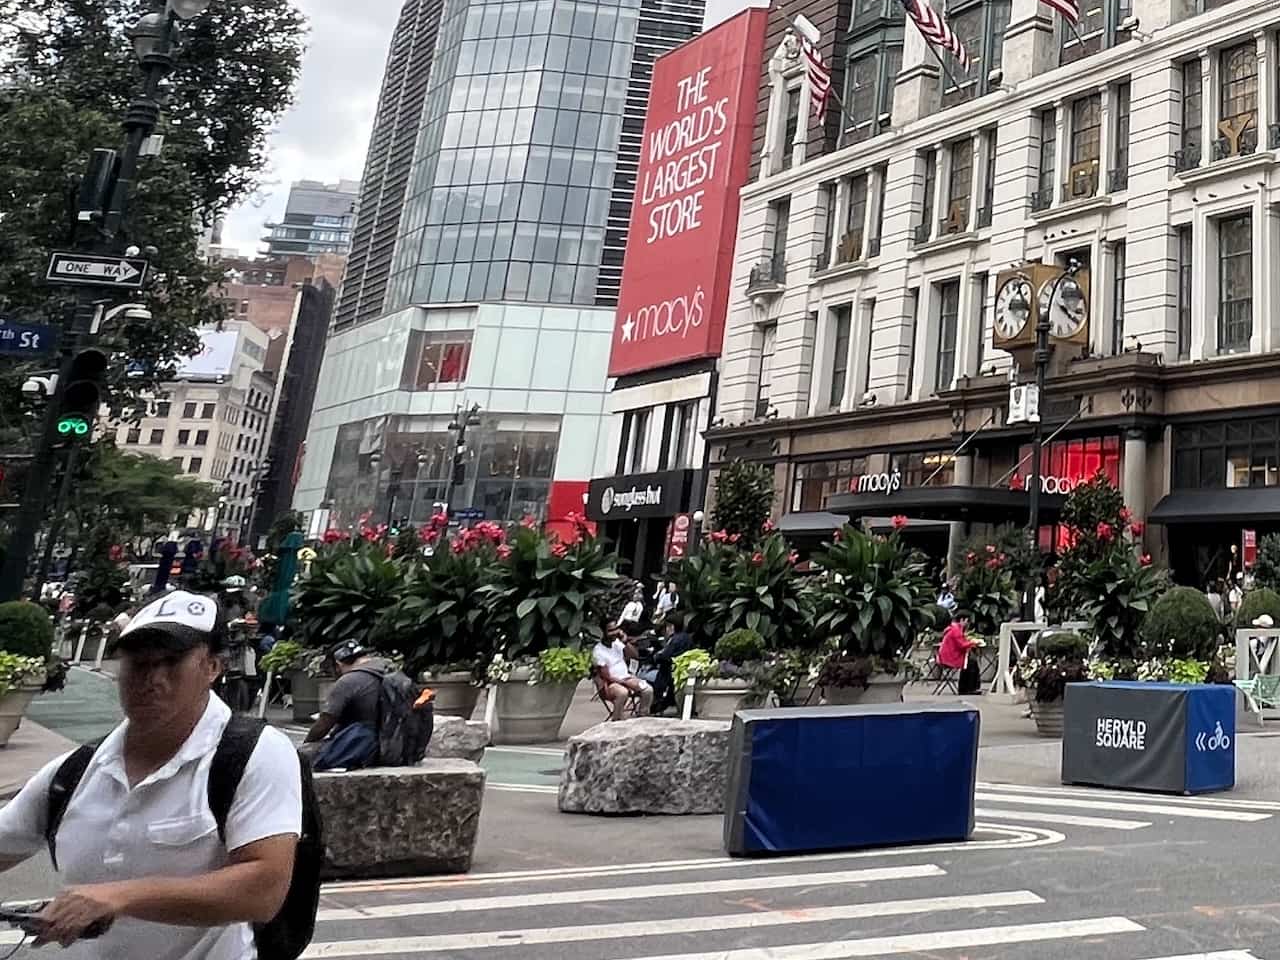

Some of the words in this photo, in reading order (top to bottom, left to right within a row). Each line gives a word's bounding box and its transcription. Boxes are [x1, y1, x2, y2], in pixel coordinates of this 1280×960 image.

[678, 66, 712, 113] THE
[650, 97, 729, 164] WORLD'S
[642, 141, 722, 205] LARGEST
[647, 190, 704, 244] STORE
[65, 262, 91, 274] ONE
[103, 265, 130, 276] WAY
[634, 285, 705, 341] macy's
[19, 332, 40, 348] St
[646, 485, 661, 505] hut
[858, 468, 901, 496] macy's
[1096, 733, 1145, 750] SQUARE
